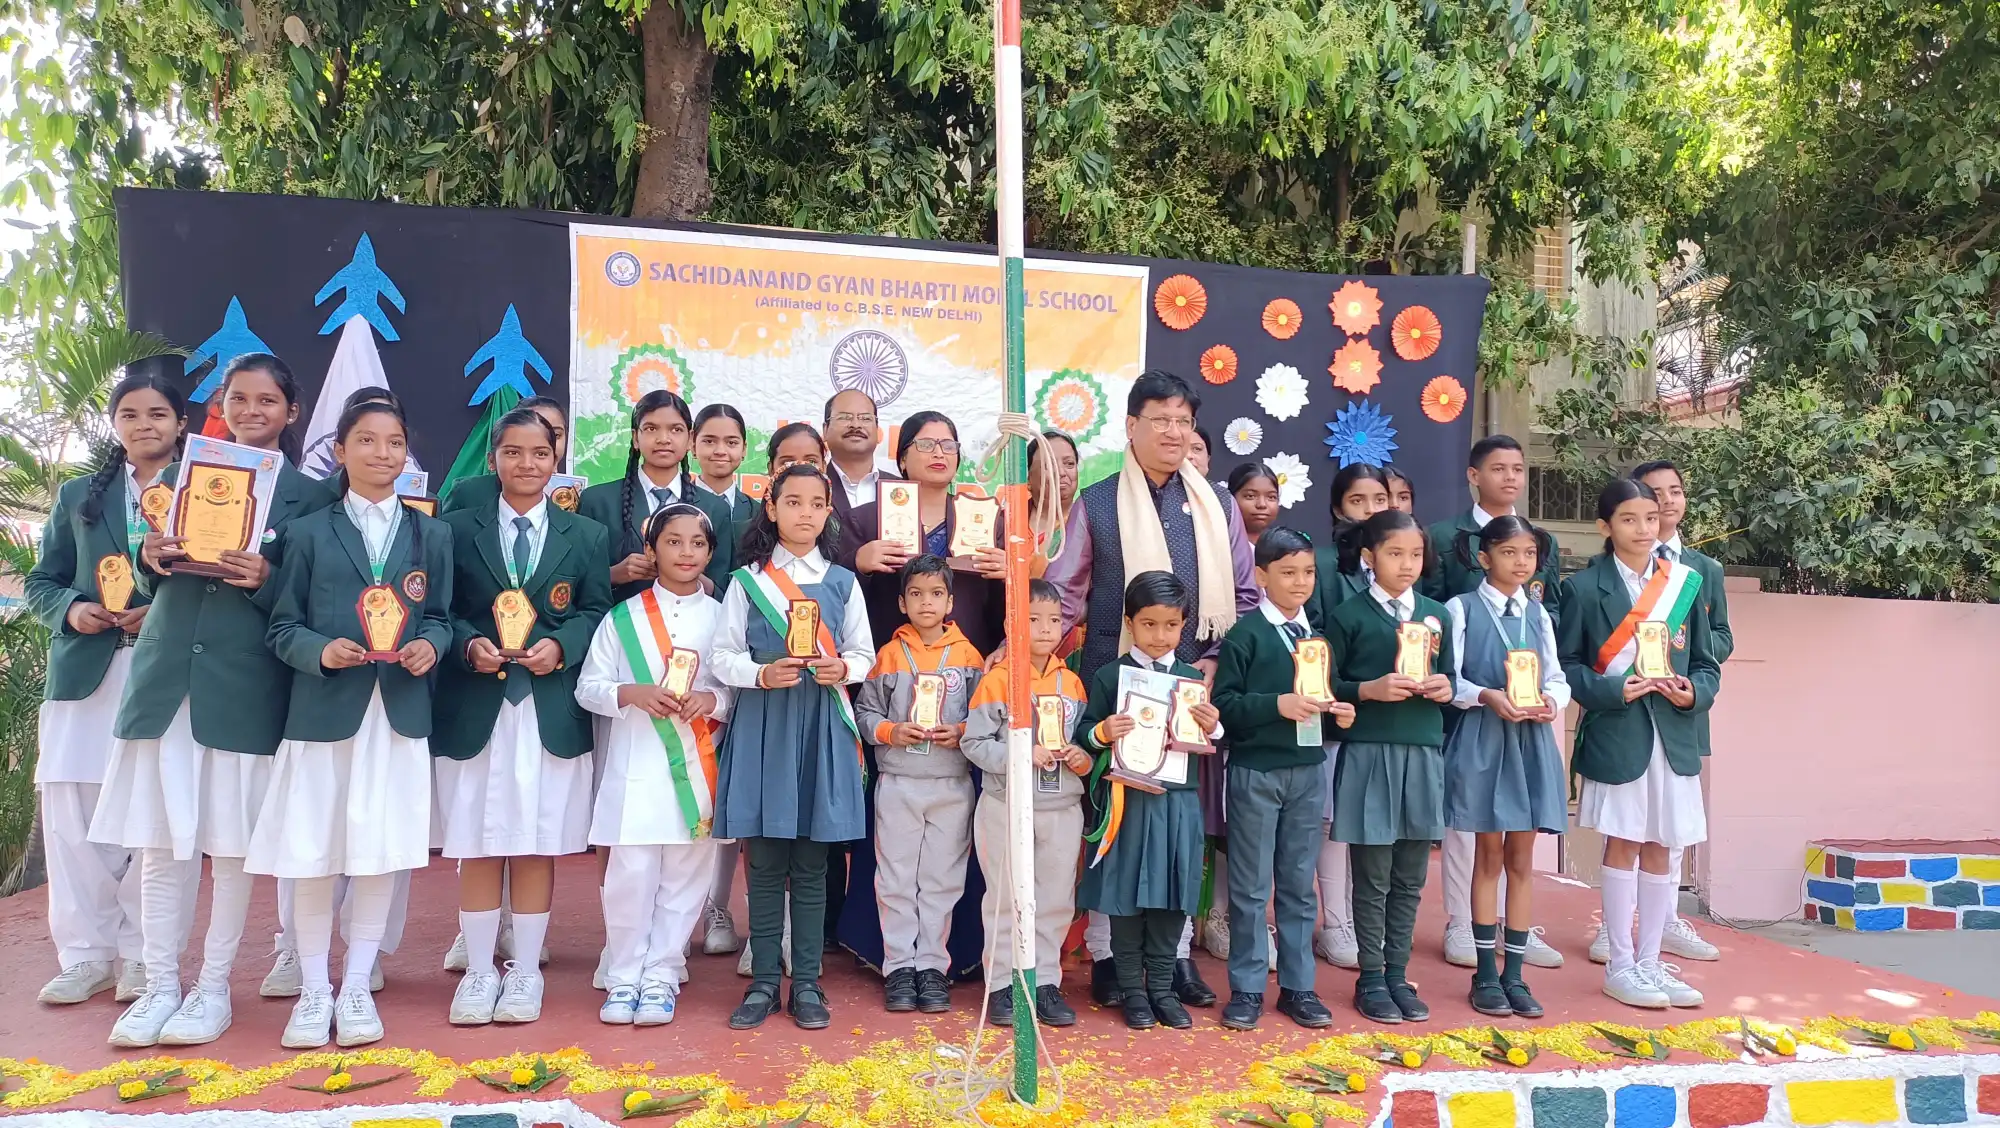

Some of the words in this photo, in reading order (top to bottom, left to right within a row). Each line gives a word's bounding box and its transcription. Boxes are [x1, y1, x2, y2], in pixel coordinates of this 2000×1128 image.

[649, 262, 811, 292] SACHIDANAND
[817, 274, 875, 296] GYAN
[880, 278, 957, 302] BHARTI
[963, 287, 1034, 308] MOL
[1039, 290, 1118, 313] SCHOOL
[755, 296, 822, 312] (Affiliated
[826, 301, 840, 313] to
[844, 302, 898, 317] C.B.S.E.
[901, 306, 934, 319] NEW
[937, 308, 983, 325] DELHI)
